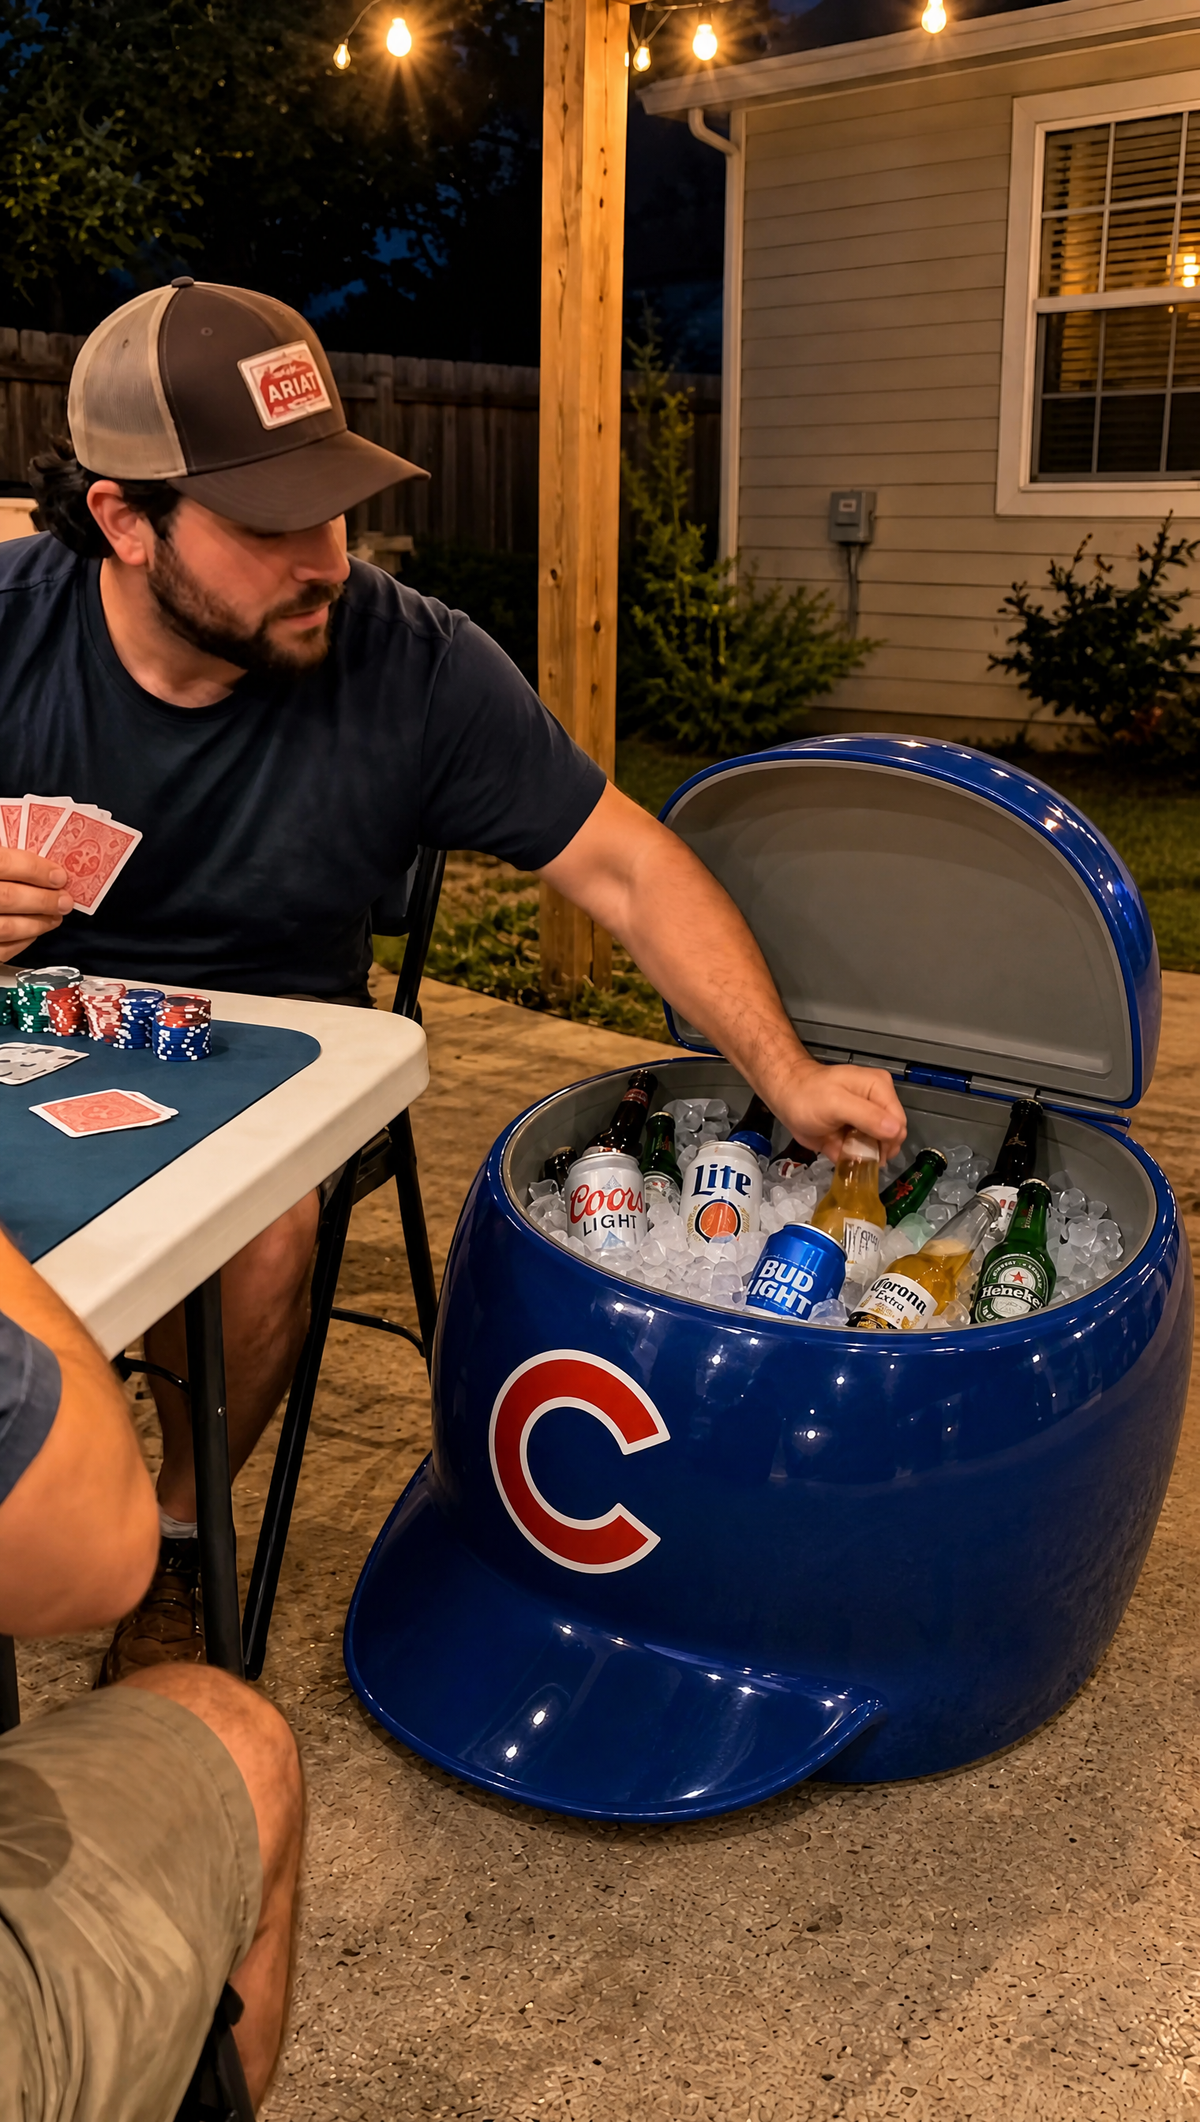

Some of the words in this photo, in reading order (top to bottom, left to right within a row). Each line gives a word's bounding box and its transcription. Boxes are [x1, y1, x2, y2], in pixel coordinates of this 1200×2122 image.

[268, 371, 318, 403] ARIAT
[691, 1164, 751, 1197] Lite
[570, 1184, 643, 1224] Coors
[583, 1214, 637, 1237] LIGHT
[758, 1259, 814, 1293] BUD
[870, 1277, 927, 1315] Corona
[875, 1289, 905, 1313] Extra
[488, 1348, 671, 1575] C
